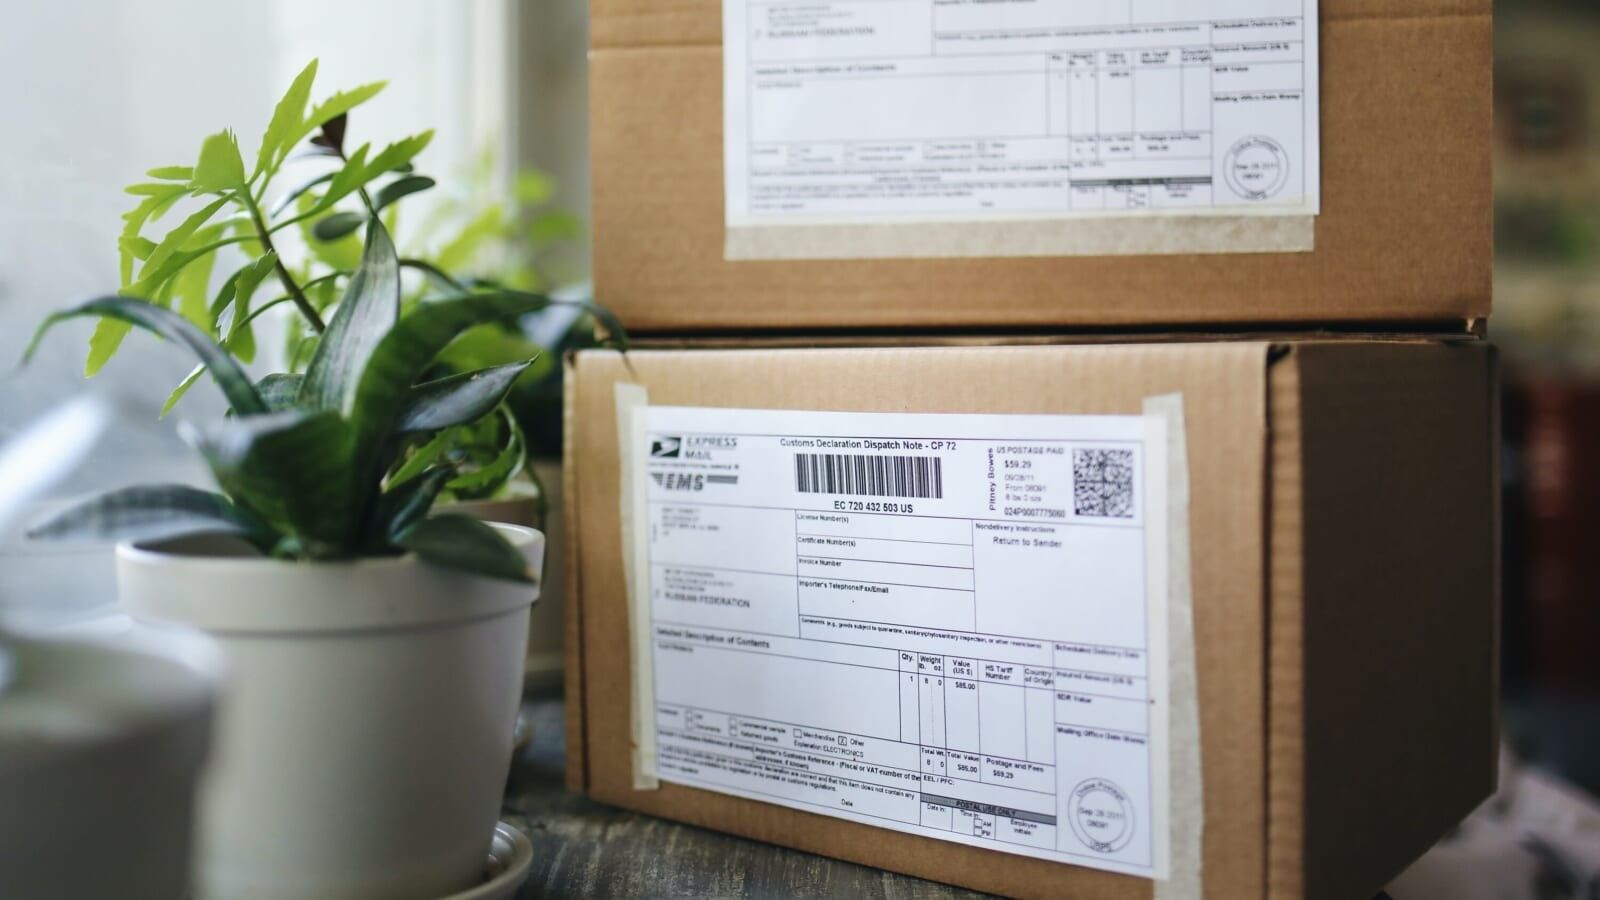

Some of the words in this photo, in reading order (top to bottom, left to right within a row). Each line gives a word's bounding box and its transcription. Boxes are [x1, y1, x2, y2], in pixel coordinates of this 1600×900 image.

[686, 437, 738, 448] EXPRESS
[780, 438, 815, 447] Customs
[816, 438, 862, 448] Declaration
[864, 439, 901, 450] Dispatch
[903, 441, 923, 450] Note
[931, 441, 945, 450] CP
[946, 441, 957, 450] 72
[685, 450, 712, 460] MAIL
[1007, 447, 1044, 455] POSTAGE
[987, 448, 995, 479] Bowes
[1004, 460, 1032, 469] $59.29
[665, 473, 704, 491] EMS
[988, 482, 997, 511] Pitney
[834, 500, 847, 510] EC
[848, 501, 863, 511] 720
[865, 501, 881, 512] 432
[883, 502, 899, 512] 503
[900, 502, 913, 513] US
[820, 514, 849, 524] Number(s)
[975, 523, 1014, 532] Nondelivery
[798, 537, 825, 545] Certificate
[826, 538, 856, 548] Number(s)
[993, 536, 1020, 545] Return
[1022, 537, 1031, 546] to
[1033, 538, 1062, 548] Sender
[820, 559, 842, 567] Number
[799, 581, 827, 590] Importer's
[829, 582, 889, 594] Telephone/Fax/Email
[737, 636, 770, 649] Contents
[902, 653, 914, 663] Qty.
[920, 655, 942, 665] Weight
[953, 659, 971, 668] Value
[985, 664, 995, 672] HS
[953, 667, 965, 675] (US
[985, 671, 1010, 681] Number
[1025, 668, 1052, 678] Country
[823, 744, 864, 758] ELECTRONICS
[921, 747, 935, 756] Total
[947, 751, 962, 759] Total
[986, 757, 1012, 768] Postage
[1014, 761, 1027, 770] and
[1028, 764, 1044, 773] Fees
[867, 766, 878, 775] VAT
[841, 798, 854, 807] Date
[956, 800, 981, 811] POSTAL
